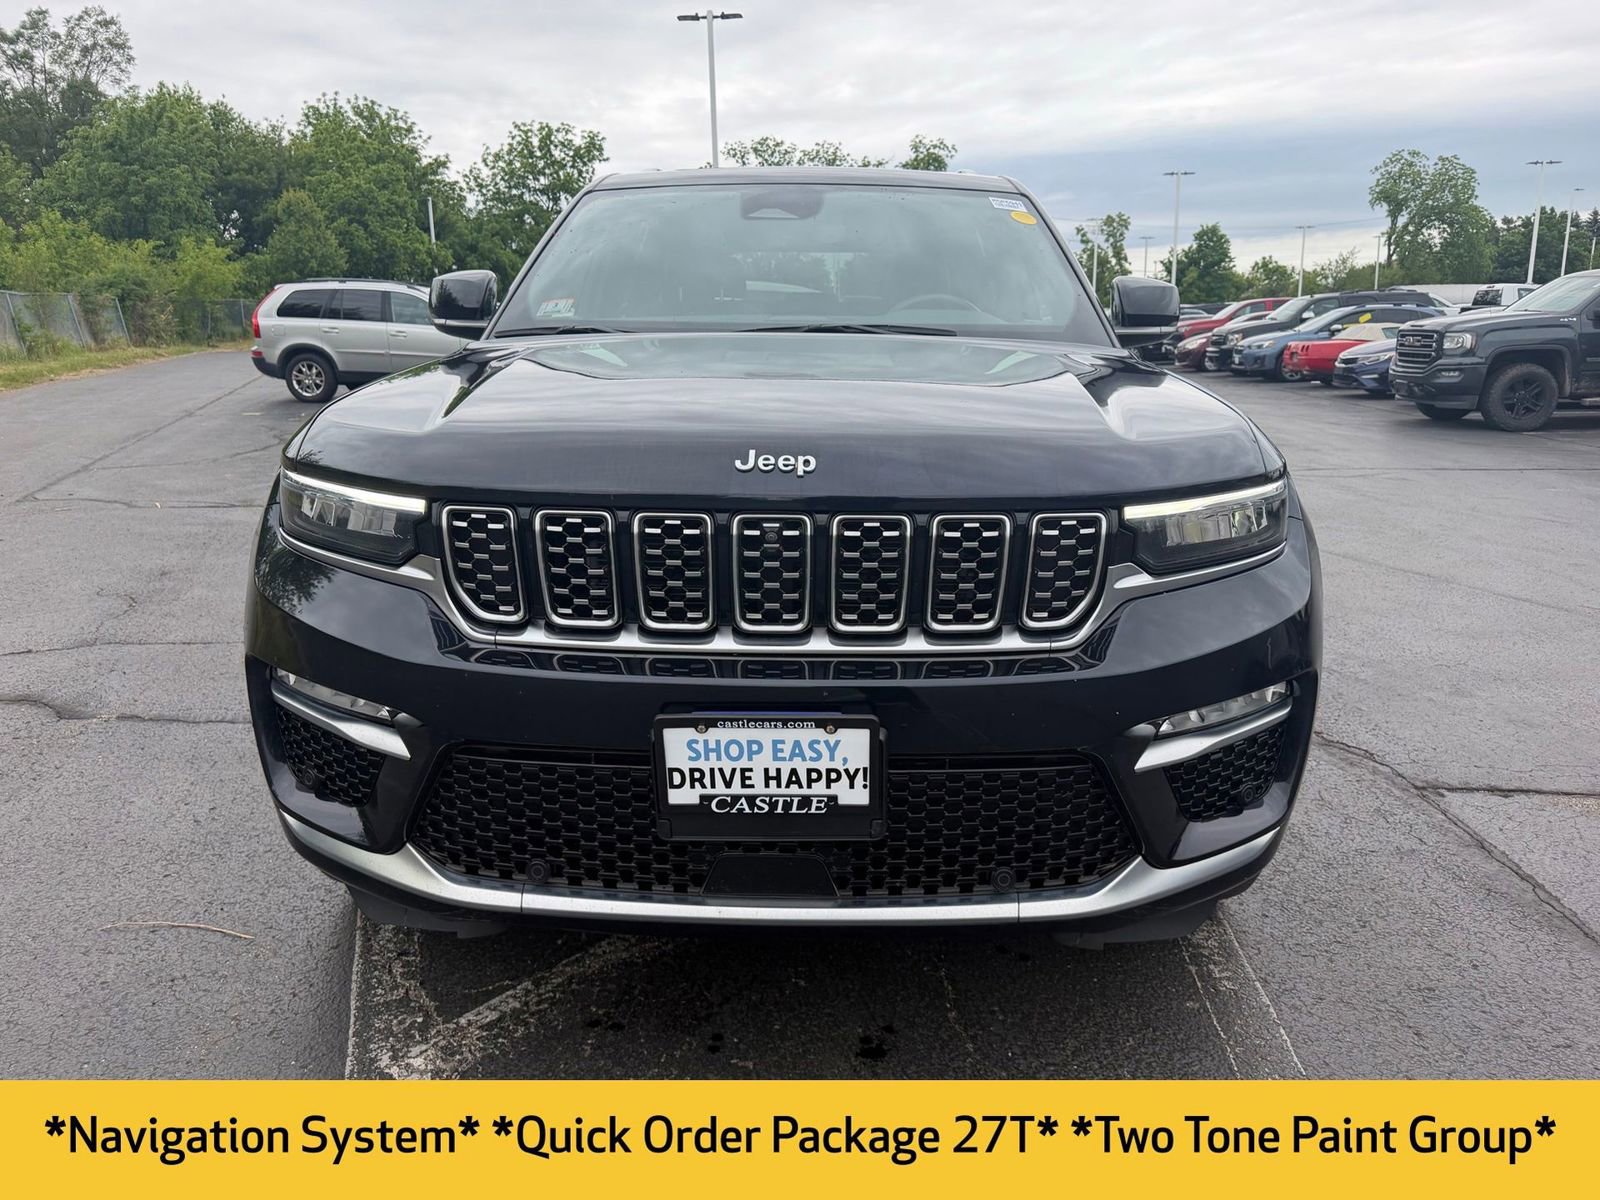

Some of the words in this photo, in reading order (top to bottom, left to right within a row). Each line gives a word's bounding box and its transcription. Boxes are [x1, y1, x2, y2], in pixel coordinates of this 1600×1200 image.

[735, 449, 817, 476] Jeep
[717, 719, 815, 729] castlecars.com
[686, 738, 764, 762] SHOP
[772, 739, 849, 766] EASY,
[668, 767, 754, 789] DRIVE
[764, 766, 869, 790] HAPPY!
[711, 796, 828, 814] CASTLE
